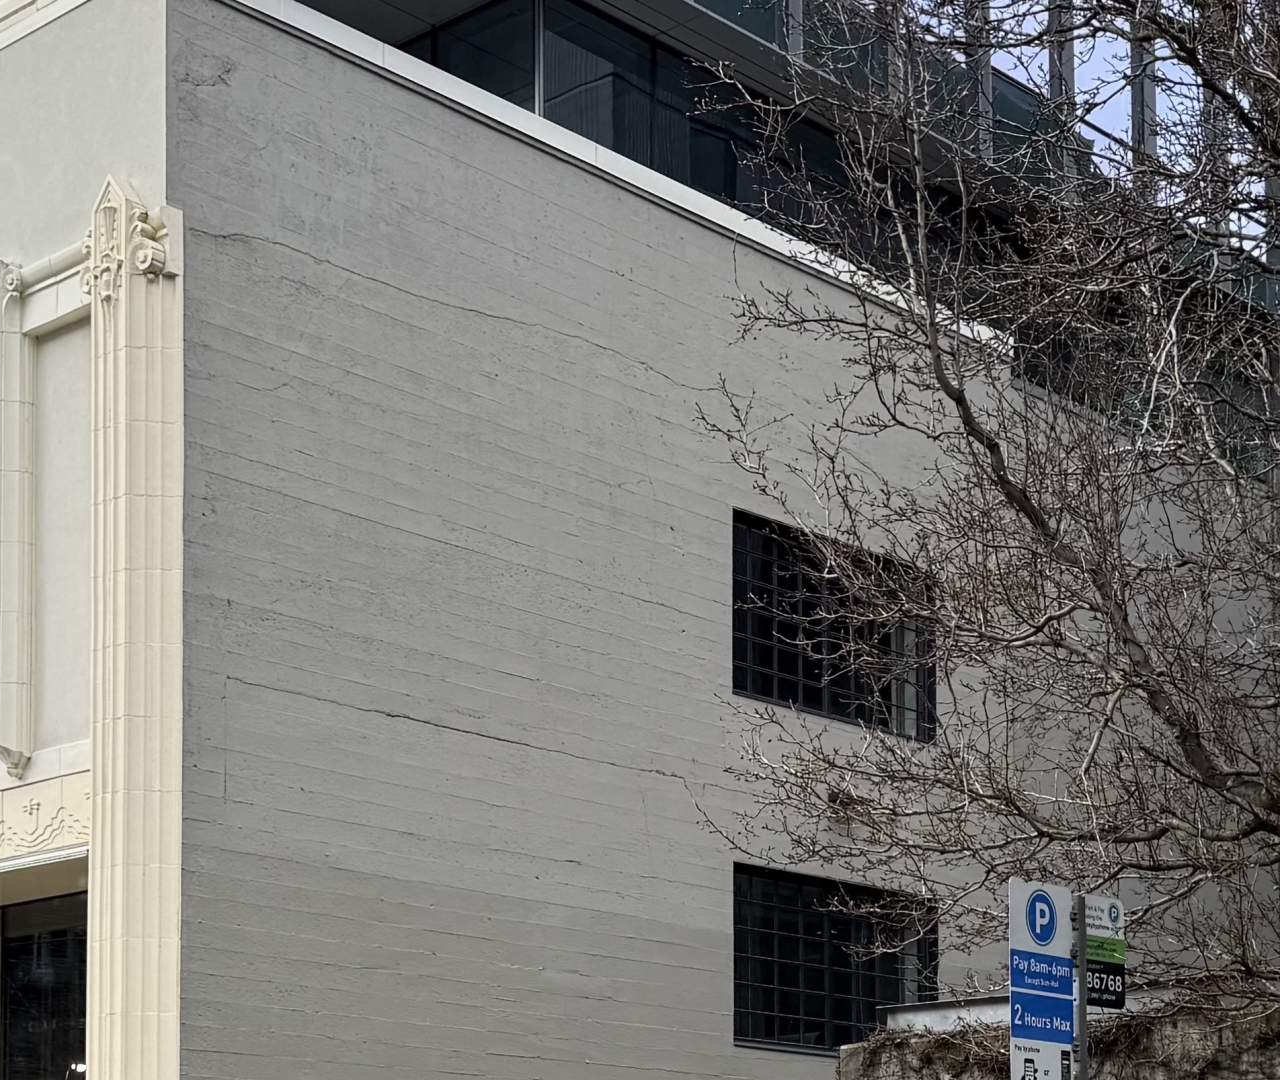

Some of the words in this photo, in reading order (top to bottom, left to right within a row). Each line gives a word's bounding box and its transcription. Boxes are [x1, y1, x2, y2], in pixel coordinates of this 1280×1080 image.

[1035, 902, 1050, 934] P
[1013, 955, 1029, 974] Pay
[1030, 958, 1071, 978] 8am-6pm
[1086, 971, 1123, 992] 86768
[1014, 1003, 1022, 1025] 2
[1024, 1012, 1051, 1029] Hours
[1053, 1016, 1072, 1032] Max
